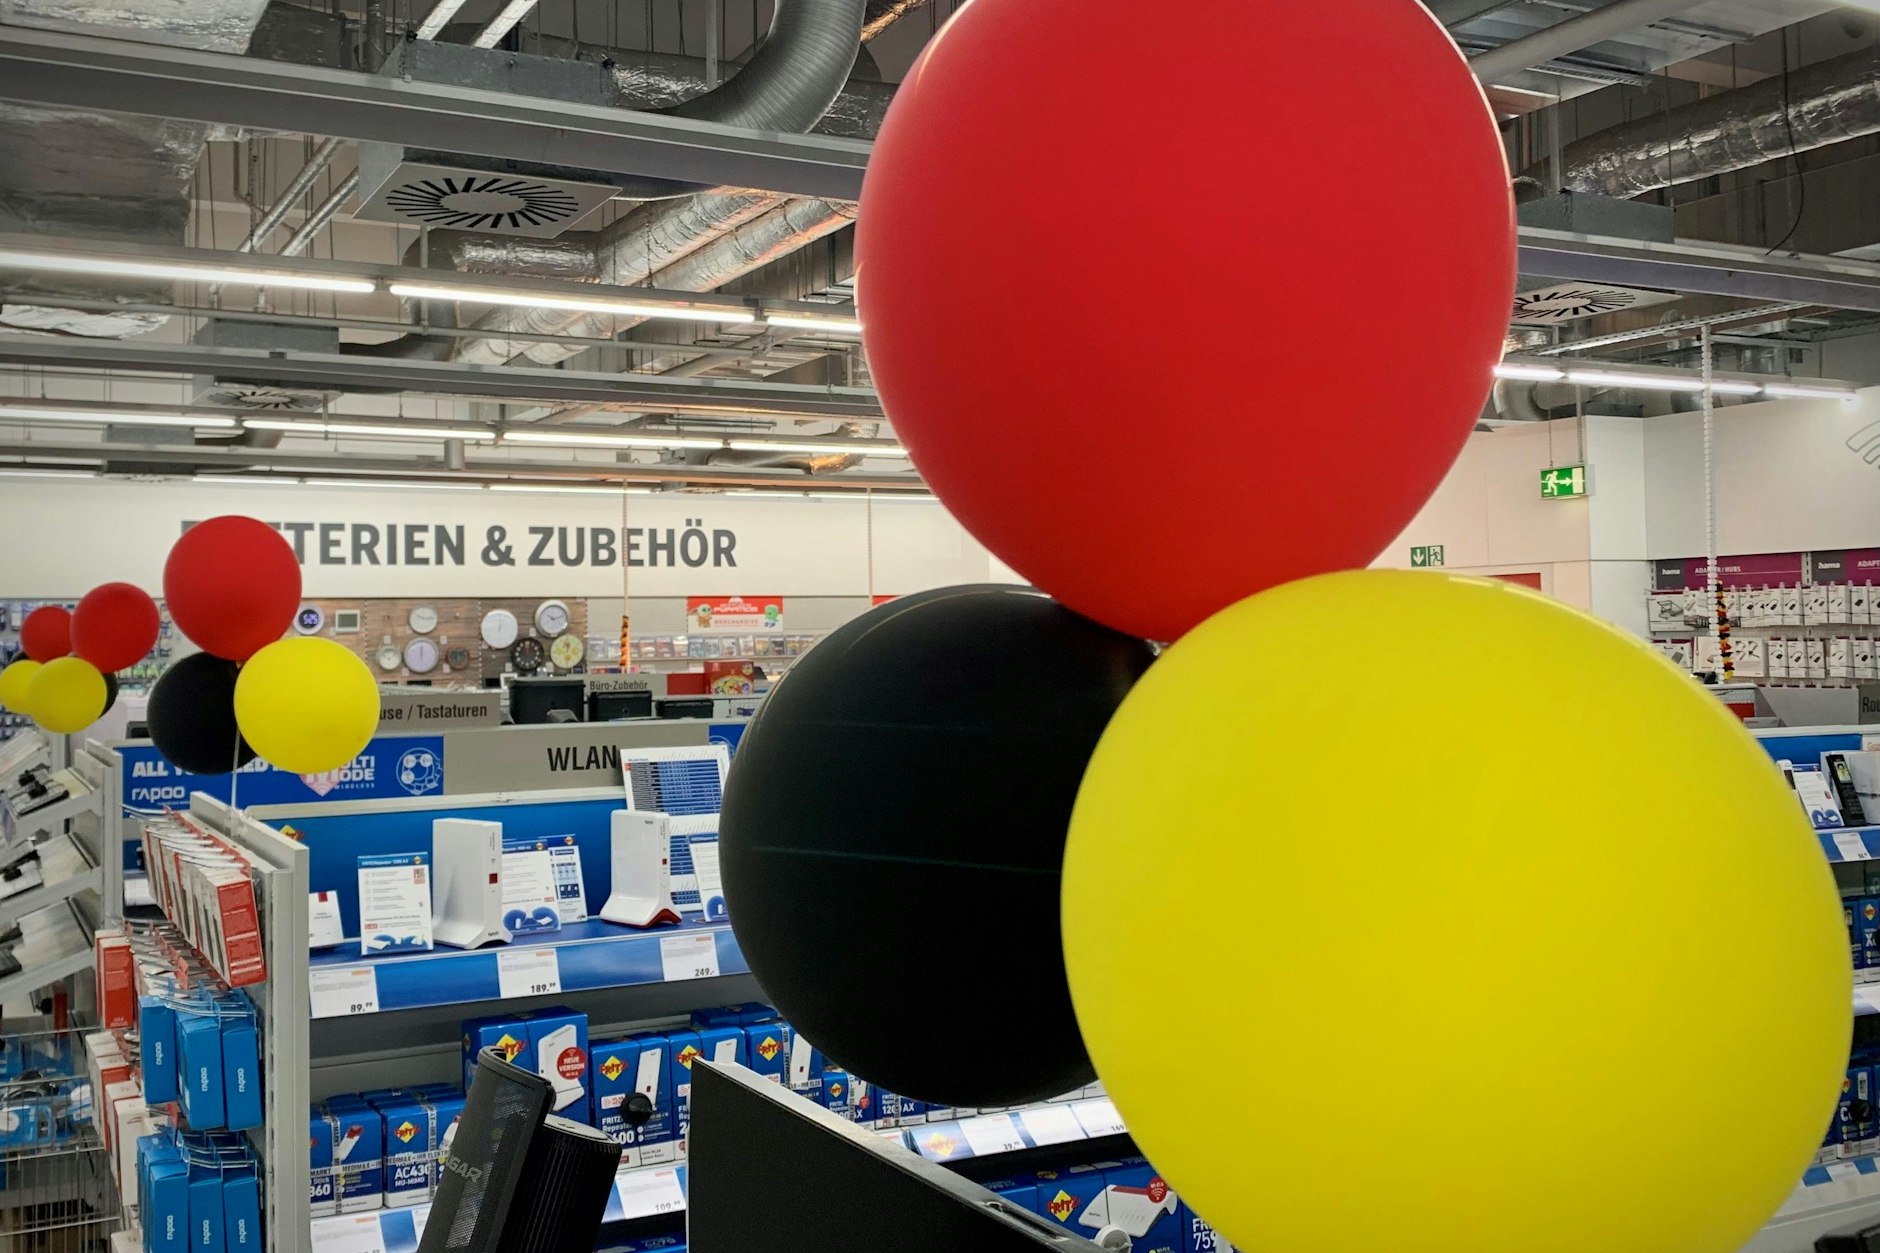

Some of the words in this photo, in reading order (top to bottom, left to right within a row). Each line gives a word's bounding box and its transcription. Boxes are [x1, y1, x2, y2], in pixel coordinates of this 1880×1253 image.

[181, 520, 465, 566] TERIEN
[481, 525, 517, 568] &
[528, 518, 738, 569] ZUBEHÖR
[589, 679, 648, 691] Büro-Zubehör
[379, 708, 403, 720] use
[407, 704, 414, 720] /
[417, 703, 488, 719] Tastaturen
[547, 745, 617, 772] WLAN
[132, 761, 168, 778] ALL
[131, 786, 185, 803] rapoo
[558, 1062, 585, 1072] VERSION
[563, 1056, 580, 1065] NEUE
[903, 1102, 915, 1112] AX
[310, 1168, 332, 1177] MARKT
[342, 1162, 370, 1173] MEDIMAX
